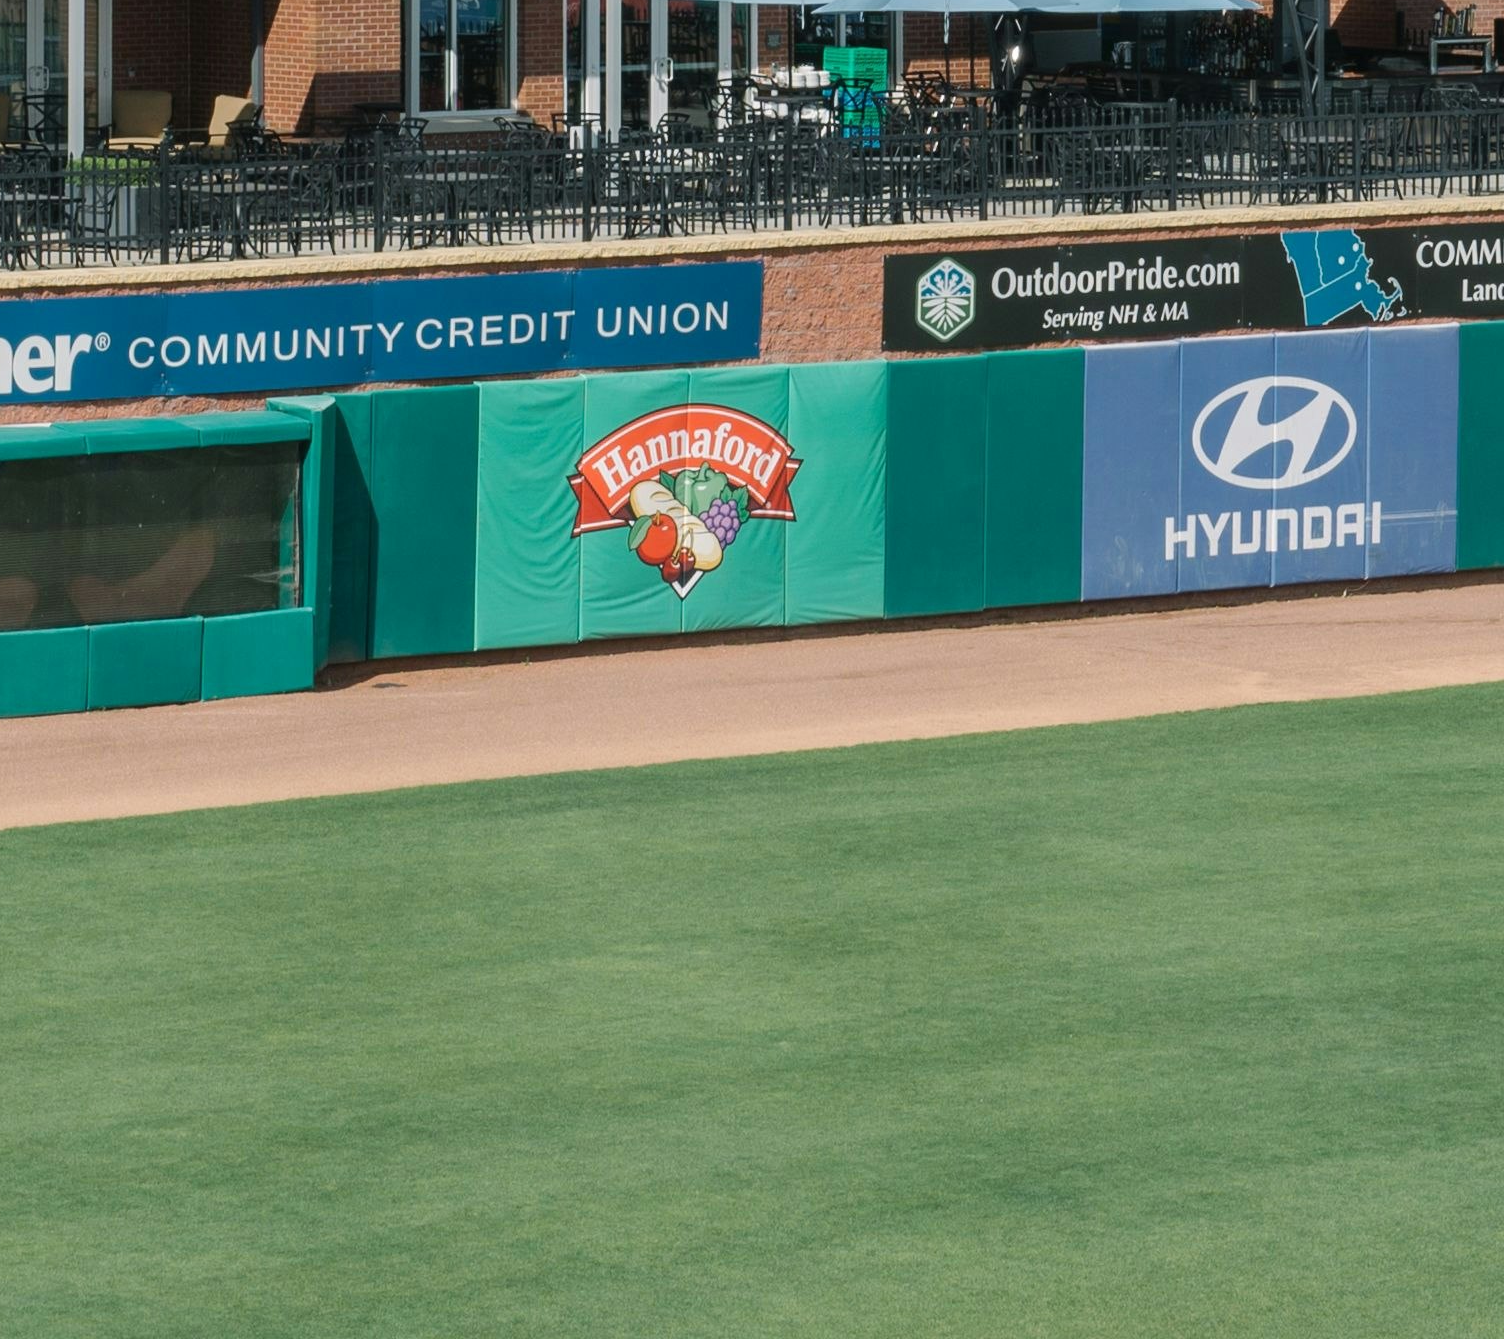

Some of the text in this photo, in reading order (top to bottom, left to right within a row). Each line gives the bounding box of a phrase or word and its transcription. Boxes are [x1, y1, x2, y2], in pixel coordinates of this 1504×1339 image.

[991, 256, 1241, 300] OutdoorPride.com
[128, 321, 405, 370] COMMUNITY
[415, 309, 576, 351] CREDIT
[596, 300, 730, 338] UNION
[1042, 300, 1190, 331] Serving NH & MA
[592, 422, 781, 498] Hannaford
[1165, 501, 1382, 561] HYUNDAI
